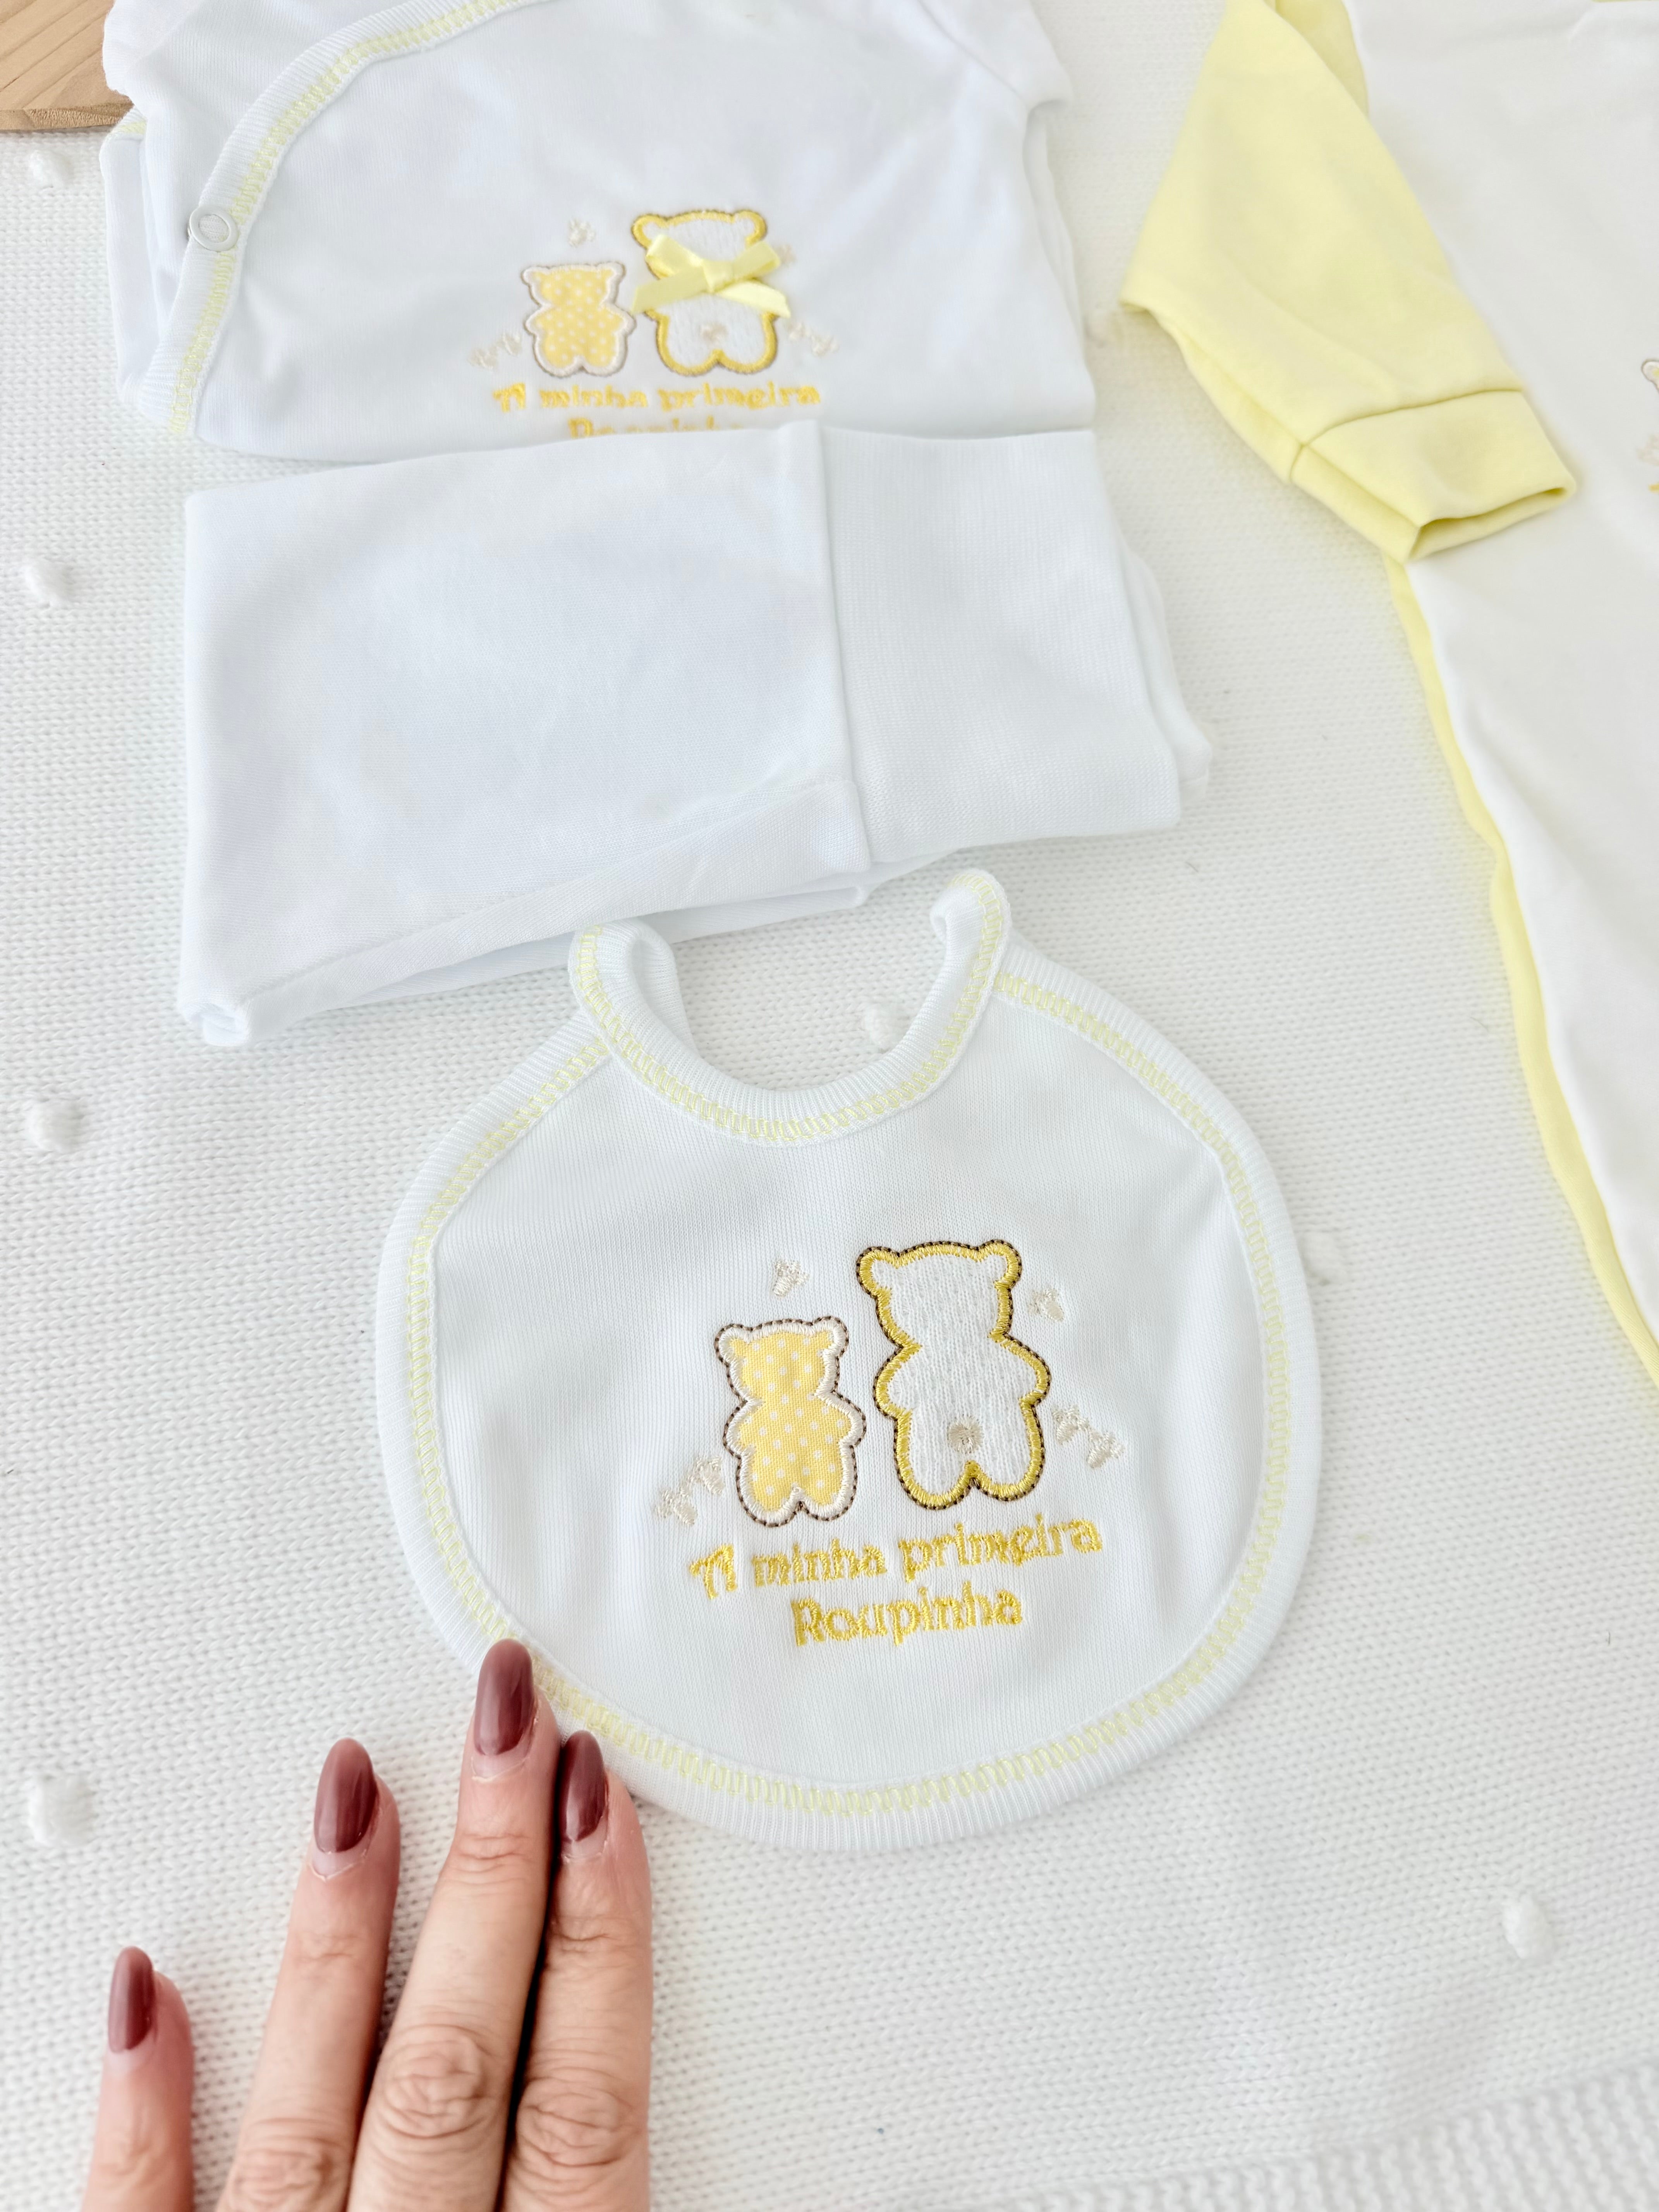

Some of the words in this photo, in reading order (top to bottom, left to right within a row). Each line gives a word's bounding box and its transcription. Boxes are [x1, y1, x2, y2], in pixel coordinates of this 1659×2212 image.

[539, 384, 648, 409] minha
[657, 381, 821, 413] primeira
[688, 1543, 738, 1600] A
[750, 1537, 888, 1588] minha
[898, 1513, 1103, 1583] primeira
[791, 1581, 1023, 1647] Roupinha
